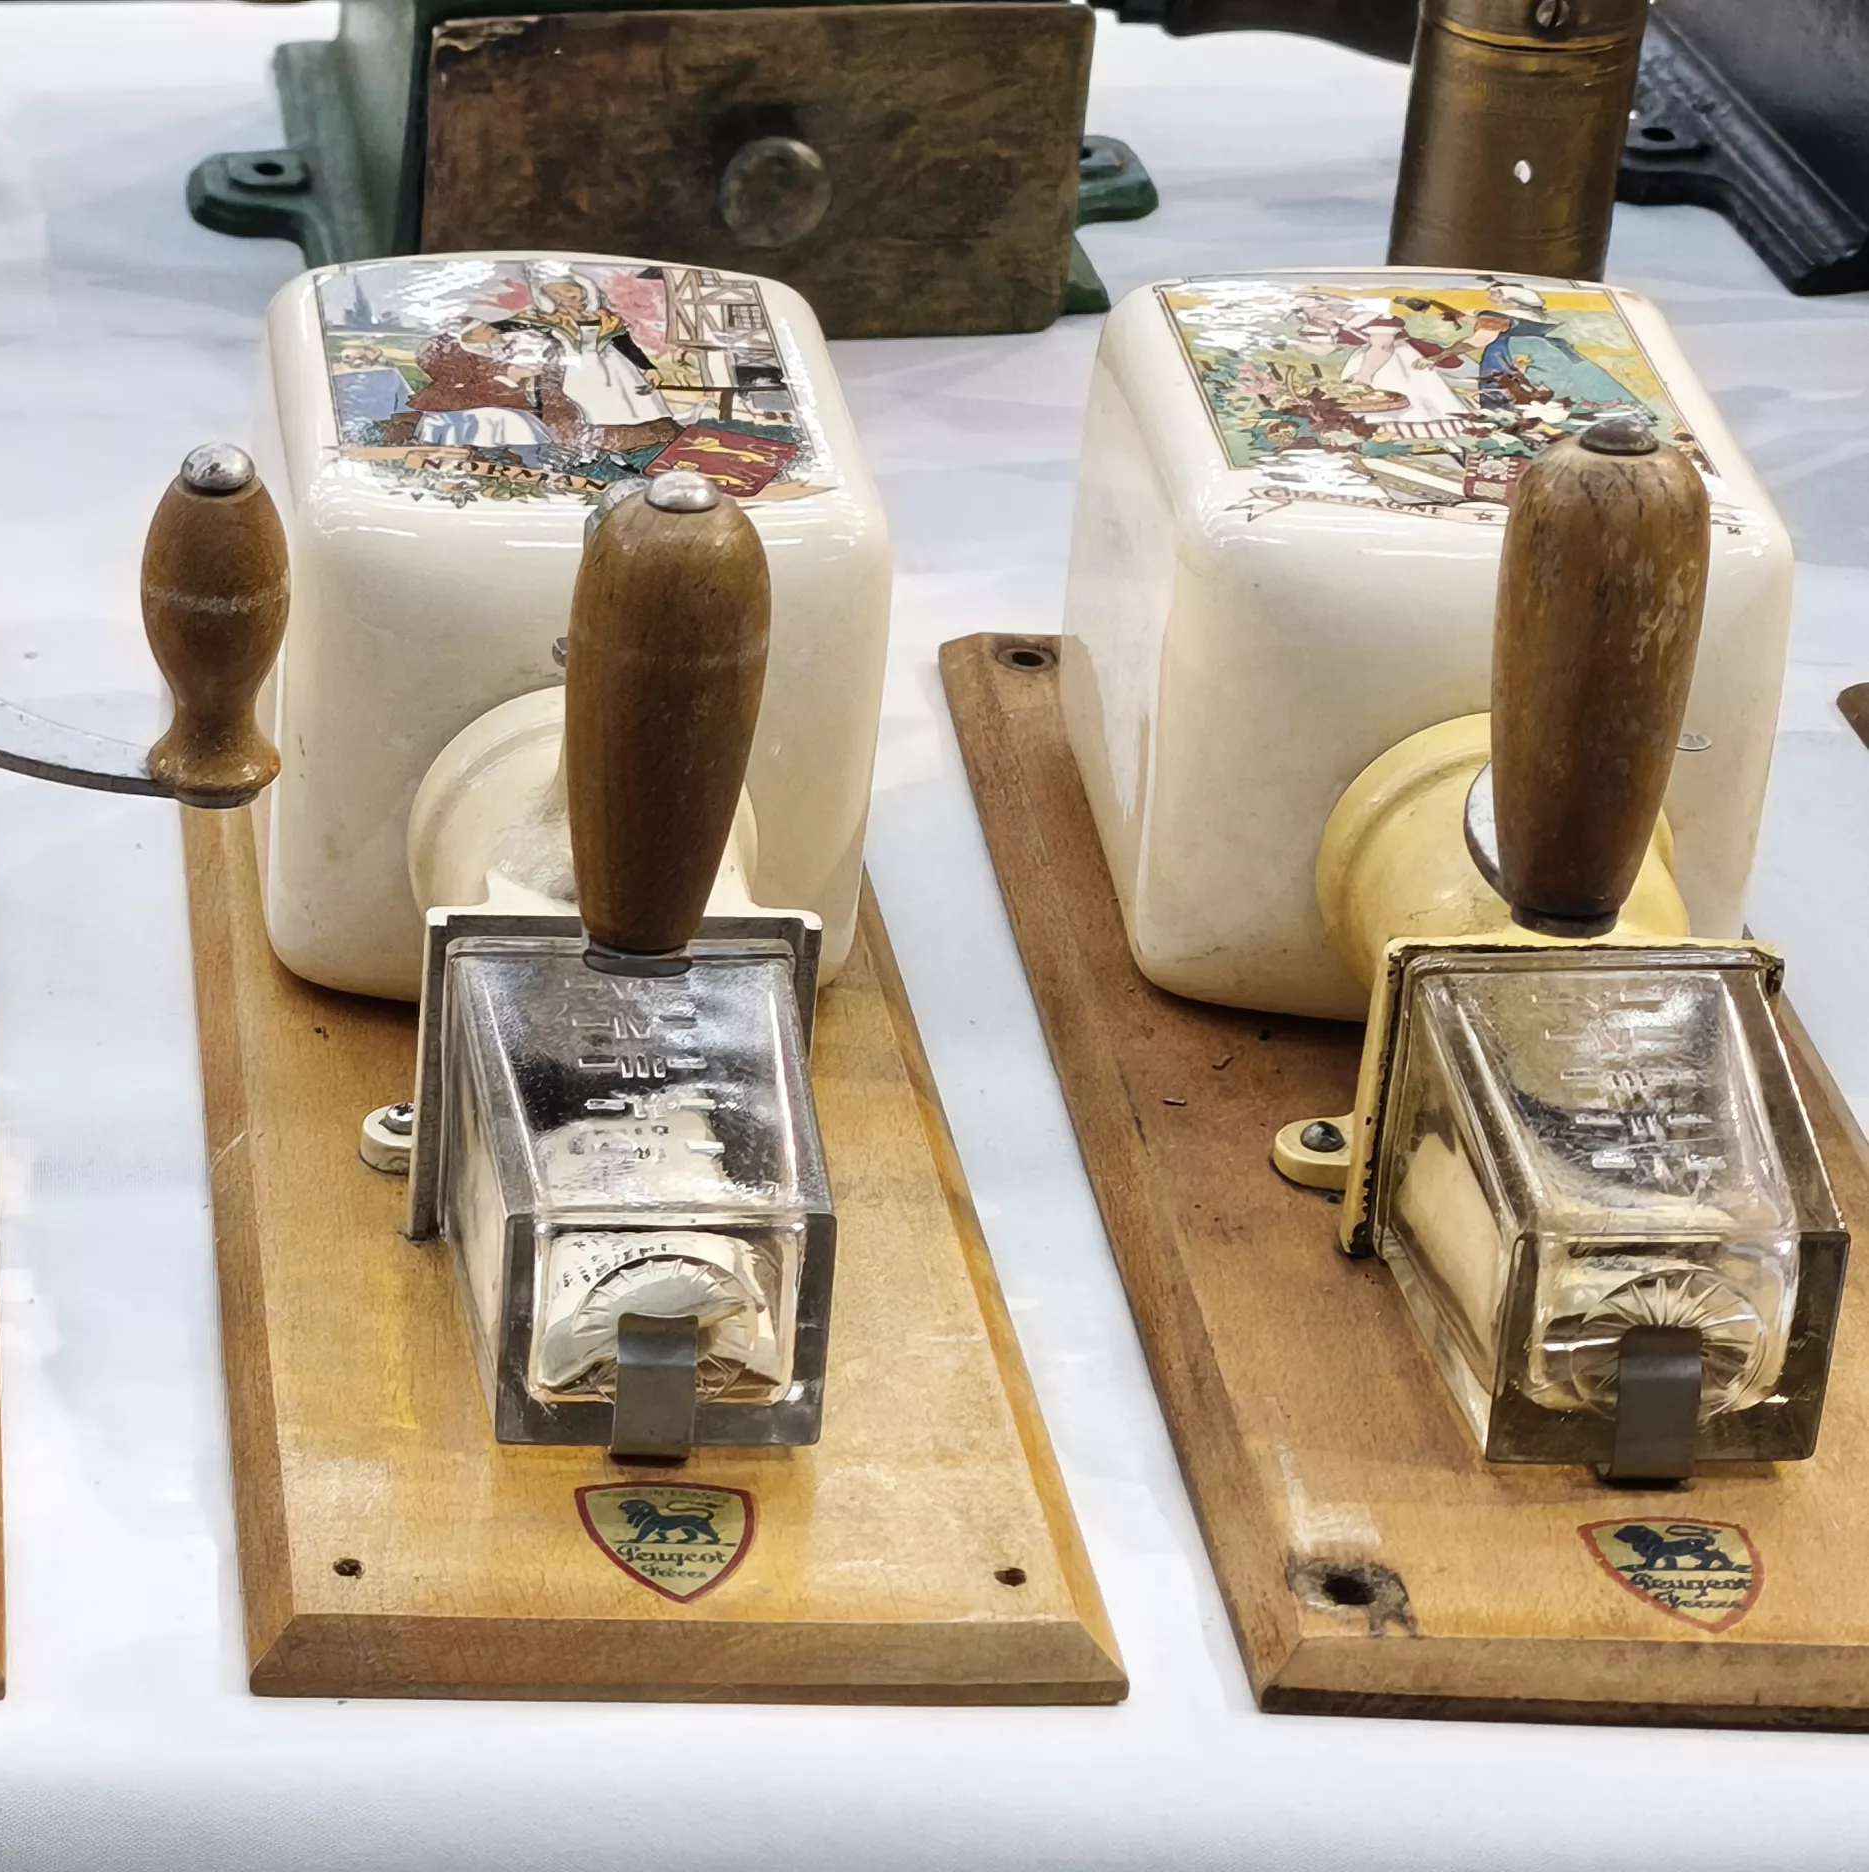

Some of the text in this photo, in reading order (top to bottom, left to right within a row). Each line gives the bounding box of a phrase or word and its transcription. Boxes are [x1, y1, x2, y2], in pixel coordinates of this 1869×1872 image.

[420, 457, 609, 493] NORMAN
[616, 1544, 728, 1567] Peugeot
[1631, 1573, 1753, 1597] Peugeot
